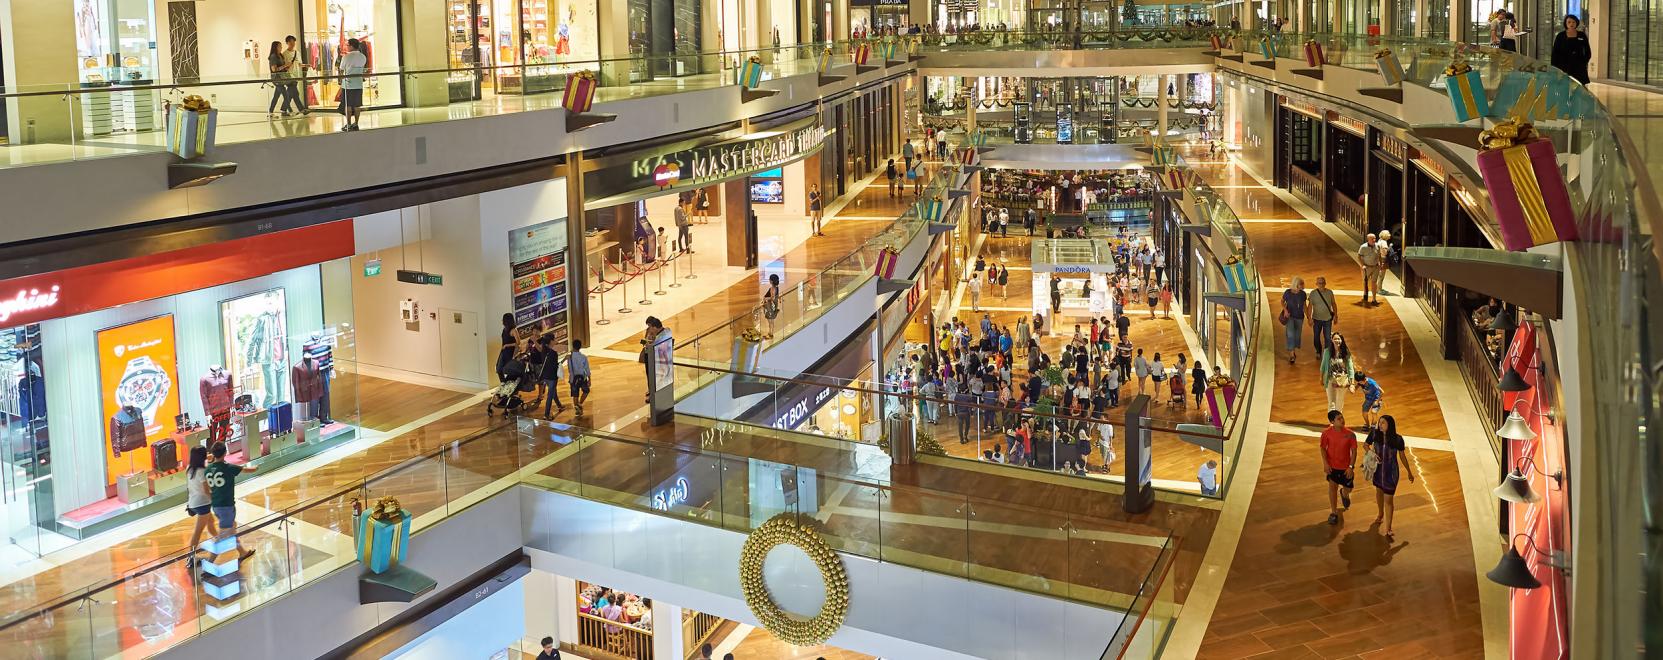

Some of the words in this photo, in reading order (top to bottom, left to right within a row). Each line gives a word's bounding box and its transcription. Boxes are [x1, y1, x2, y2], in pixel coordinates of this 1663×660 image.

[692, 138, 794, 180] MASTERCARD
[1055, 265, 1091, 273] PANDORA
[789, 397, 808, 426] BOX
[206, 471, 226, 488] 66
